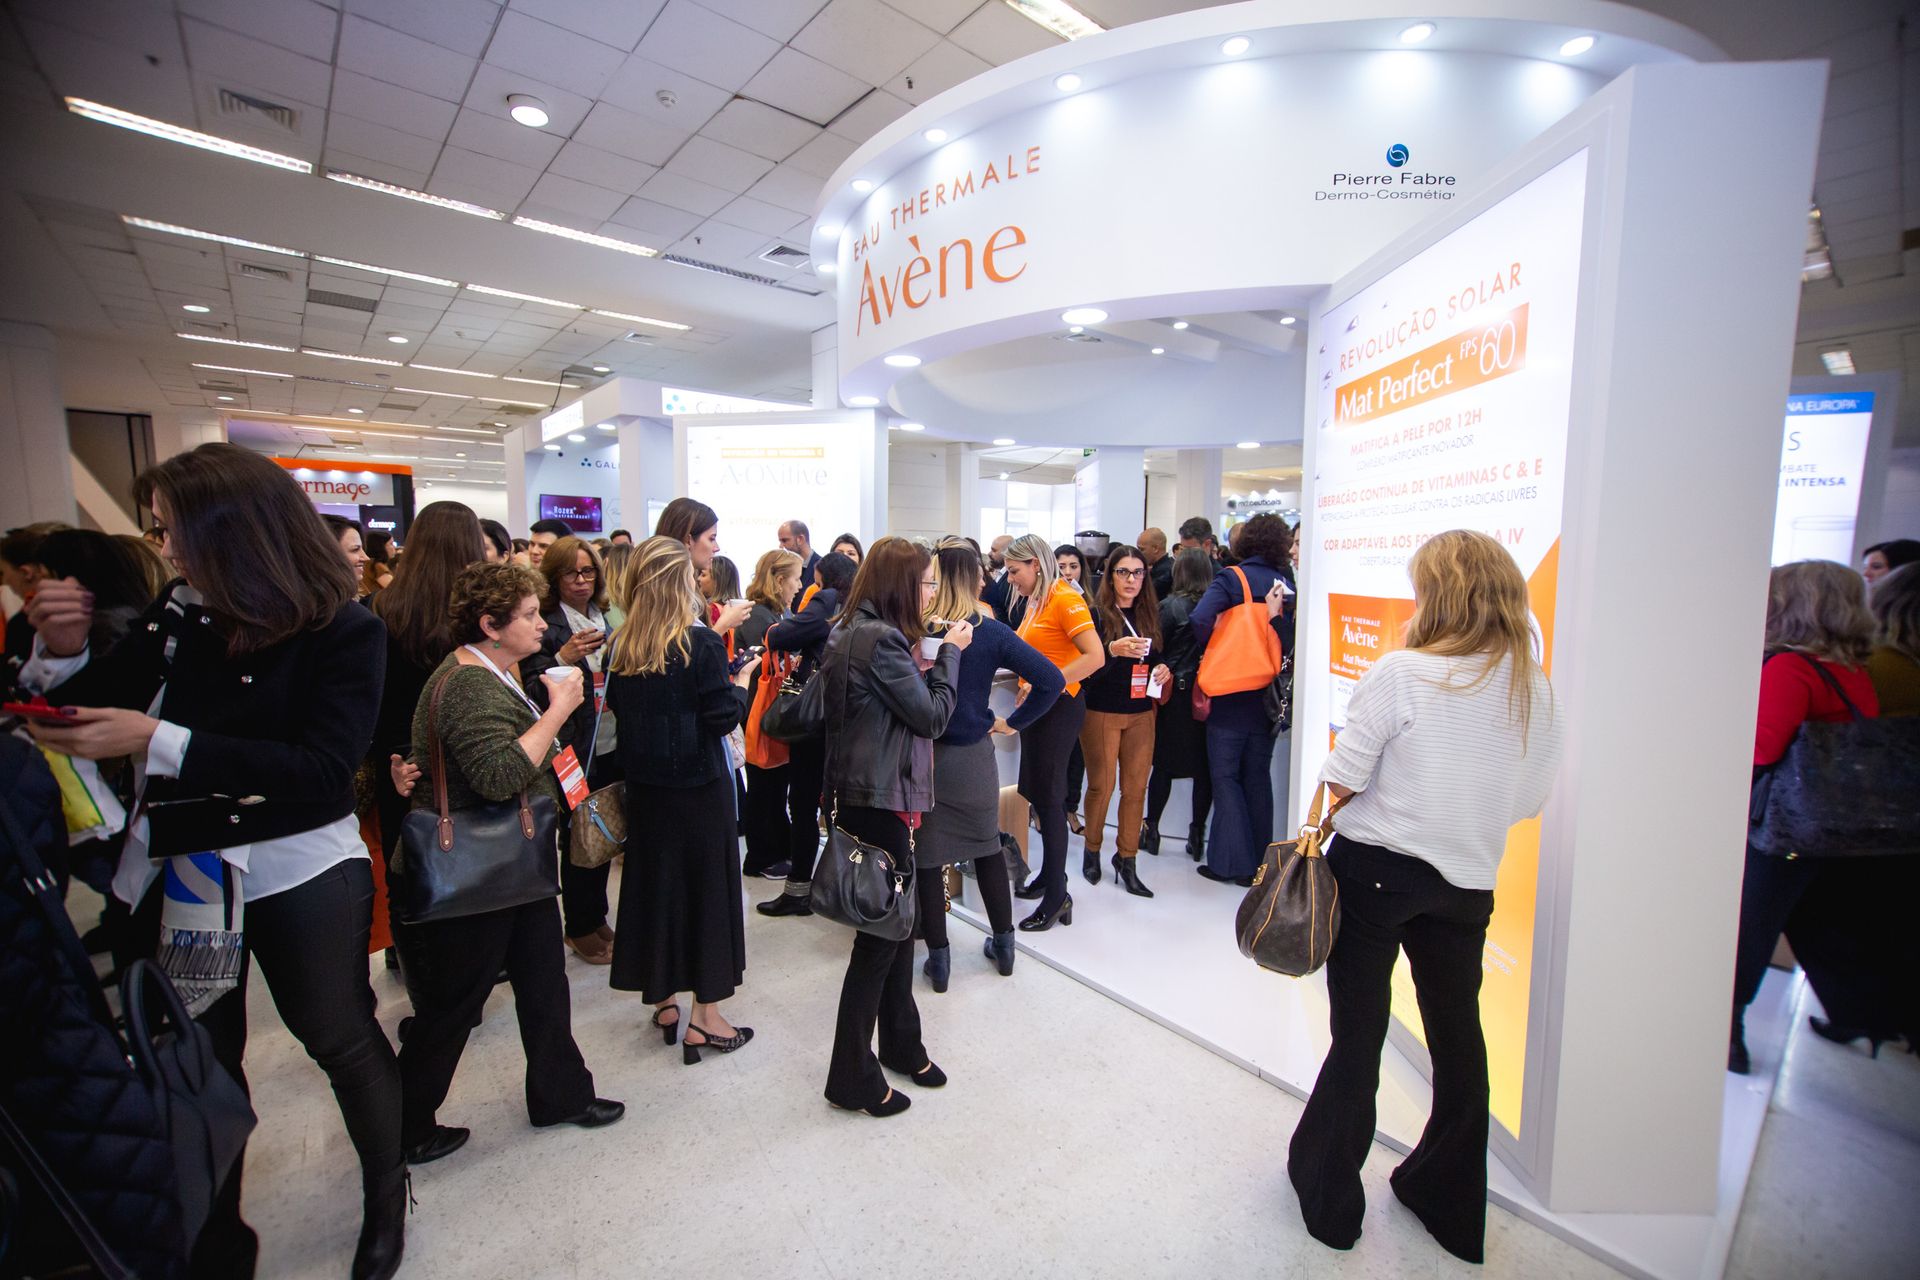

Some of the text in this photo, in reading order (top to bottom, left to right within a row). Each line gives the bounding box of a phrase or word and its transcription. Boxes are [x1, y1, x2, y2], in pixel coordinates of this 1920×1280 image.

[1333, 172, 1456, 186] Pierre Fabre
[854, 146, 1041, 261] EAU THERMALE
[856, 225, 1028, 337] Avène
[1339, 261, 1522, 373] REVOLUÇÃO SOLAR
[1339, 319, 1516, 424] Mat Perfect FPS 60
[1350, 408, 1482, 456] MATIFICA A PELE POR 12H
[595, 460, 621, 469] GAL
[1412, 479, 1424, 494] DE
[1428, 465, 1498, 491] VITAMINAS
[1503, 463, 1511, 480] C
[1517, 460, 1528, 478] &
[1534, 457, 1542, 476] E
[291, 472, 371, 501] rmage
[1507, 485, 1538, 502] LIVRES
[1785, 477, 1846, 487] INTENSA
[1324, 538, 1340, 551] COR
[1391, 535, 1412, 549] AOS
[1508, 527, 1525, 545] IV
[1341, 623, 1379, 649] Avène
